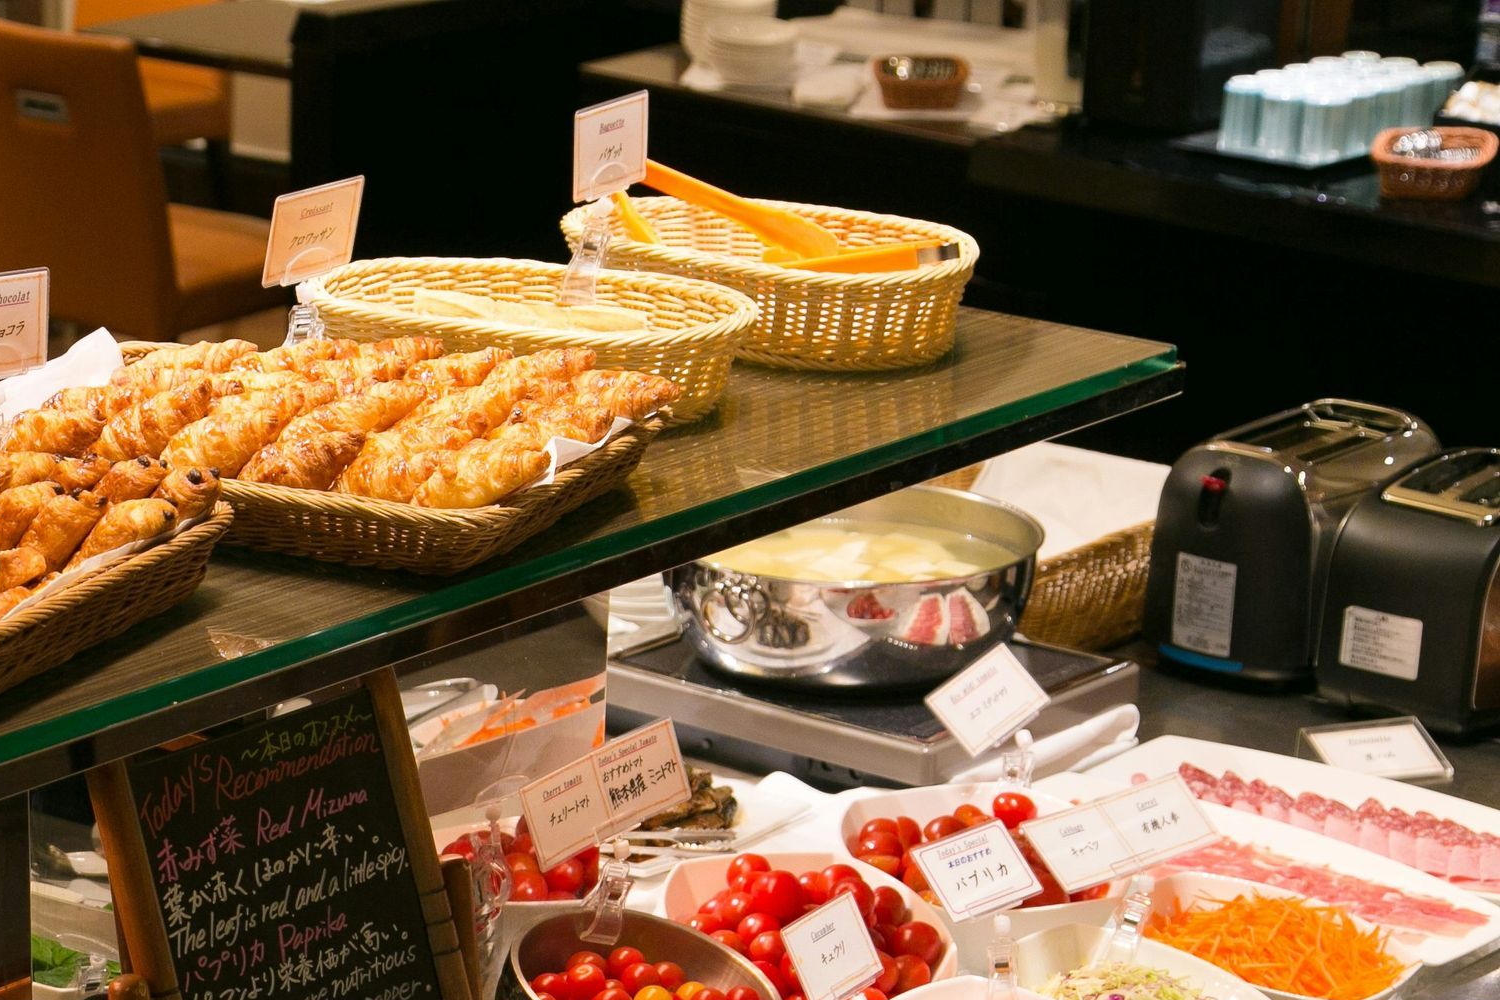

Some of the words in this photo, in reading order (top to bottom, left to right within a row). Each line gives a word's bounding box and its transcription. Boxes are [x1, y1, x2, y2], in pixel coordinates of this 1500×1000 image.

[288, 227, 337, 250] クロワッサン
[216, 730, 380, 809] Recommendation
[156, 815, 246, 883] 赤みず菜
[257, 806, 294, 846] Red
[301, 787, 368, 828] Mizuna
[549, 794, 590, 827] チェリートマト
[169, 922, 206, 959] The
[210, 904, 243, 948] leaf
[245, 908, 257, 932] is
[295, 868, 327, 911] and
[329, 875, 340, 896] a
[343, 850, 376, 892] little
[184, 939, 266, 992] パプリカ
[278, 905, 348, 963] Paprika
[332, 945, 417, 998] nutritious
[821, 940, 845, 964] キュウリ
